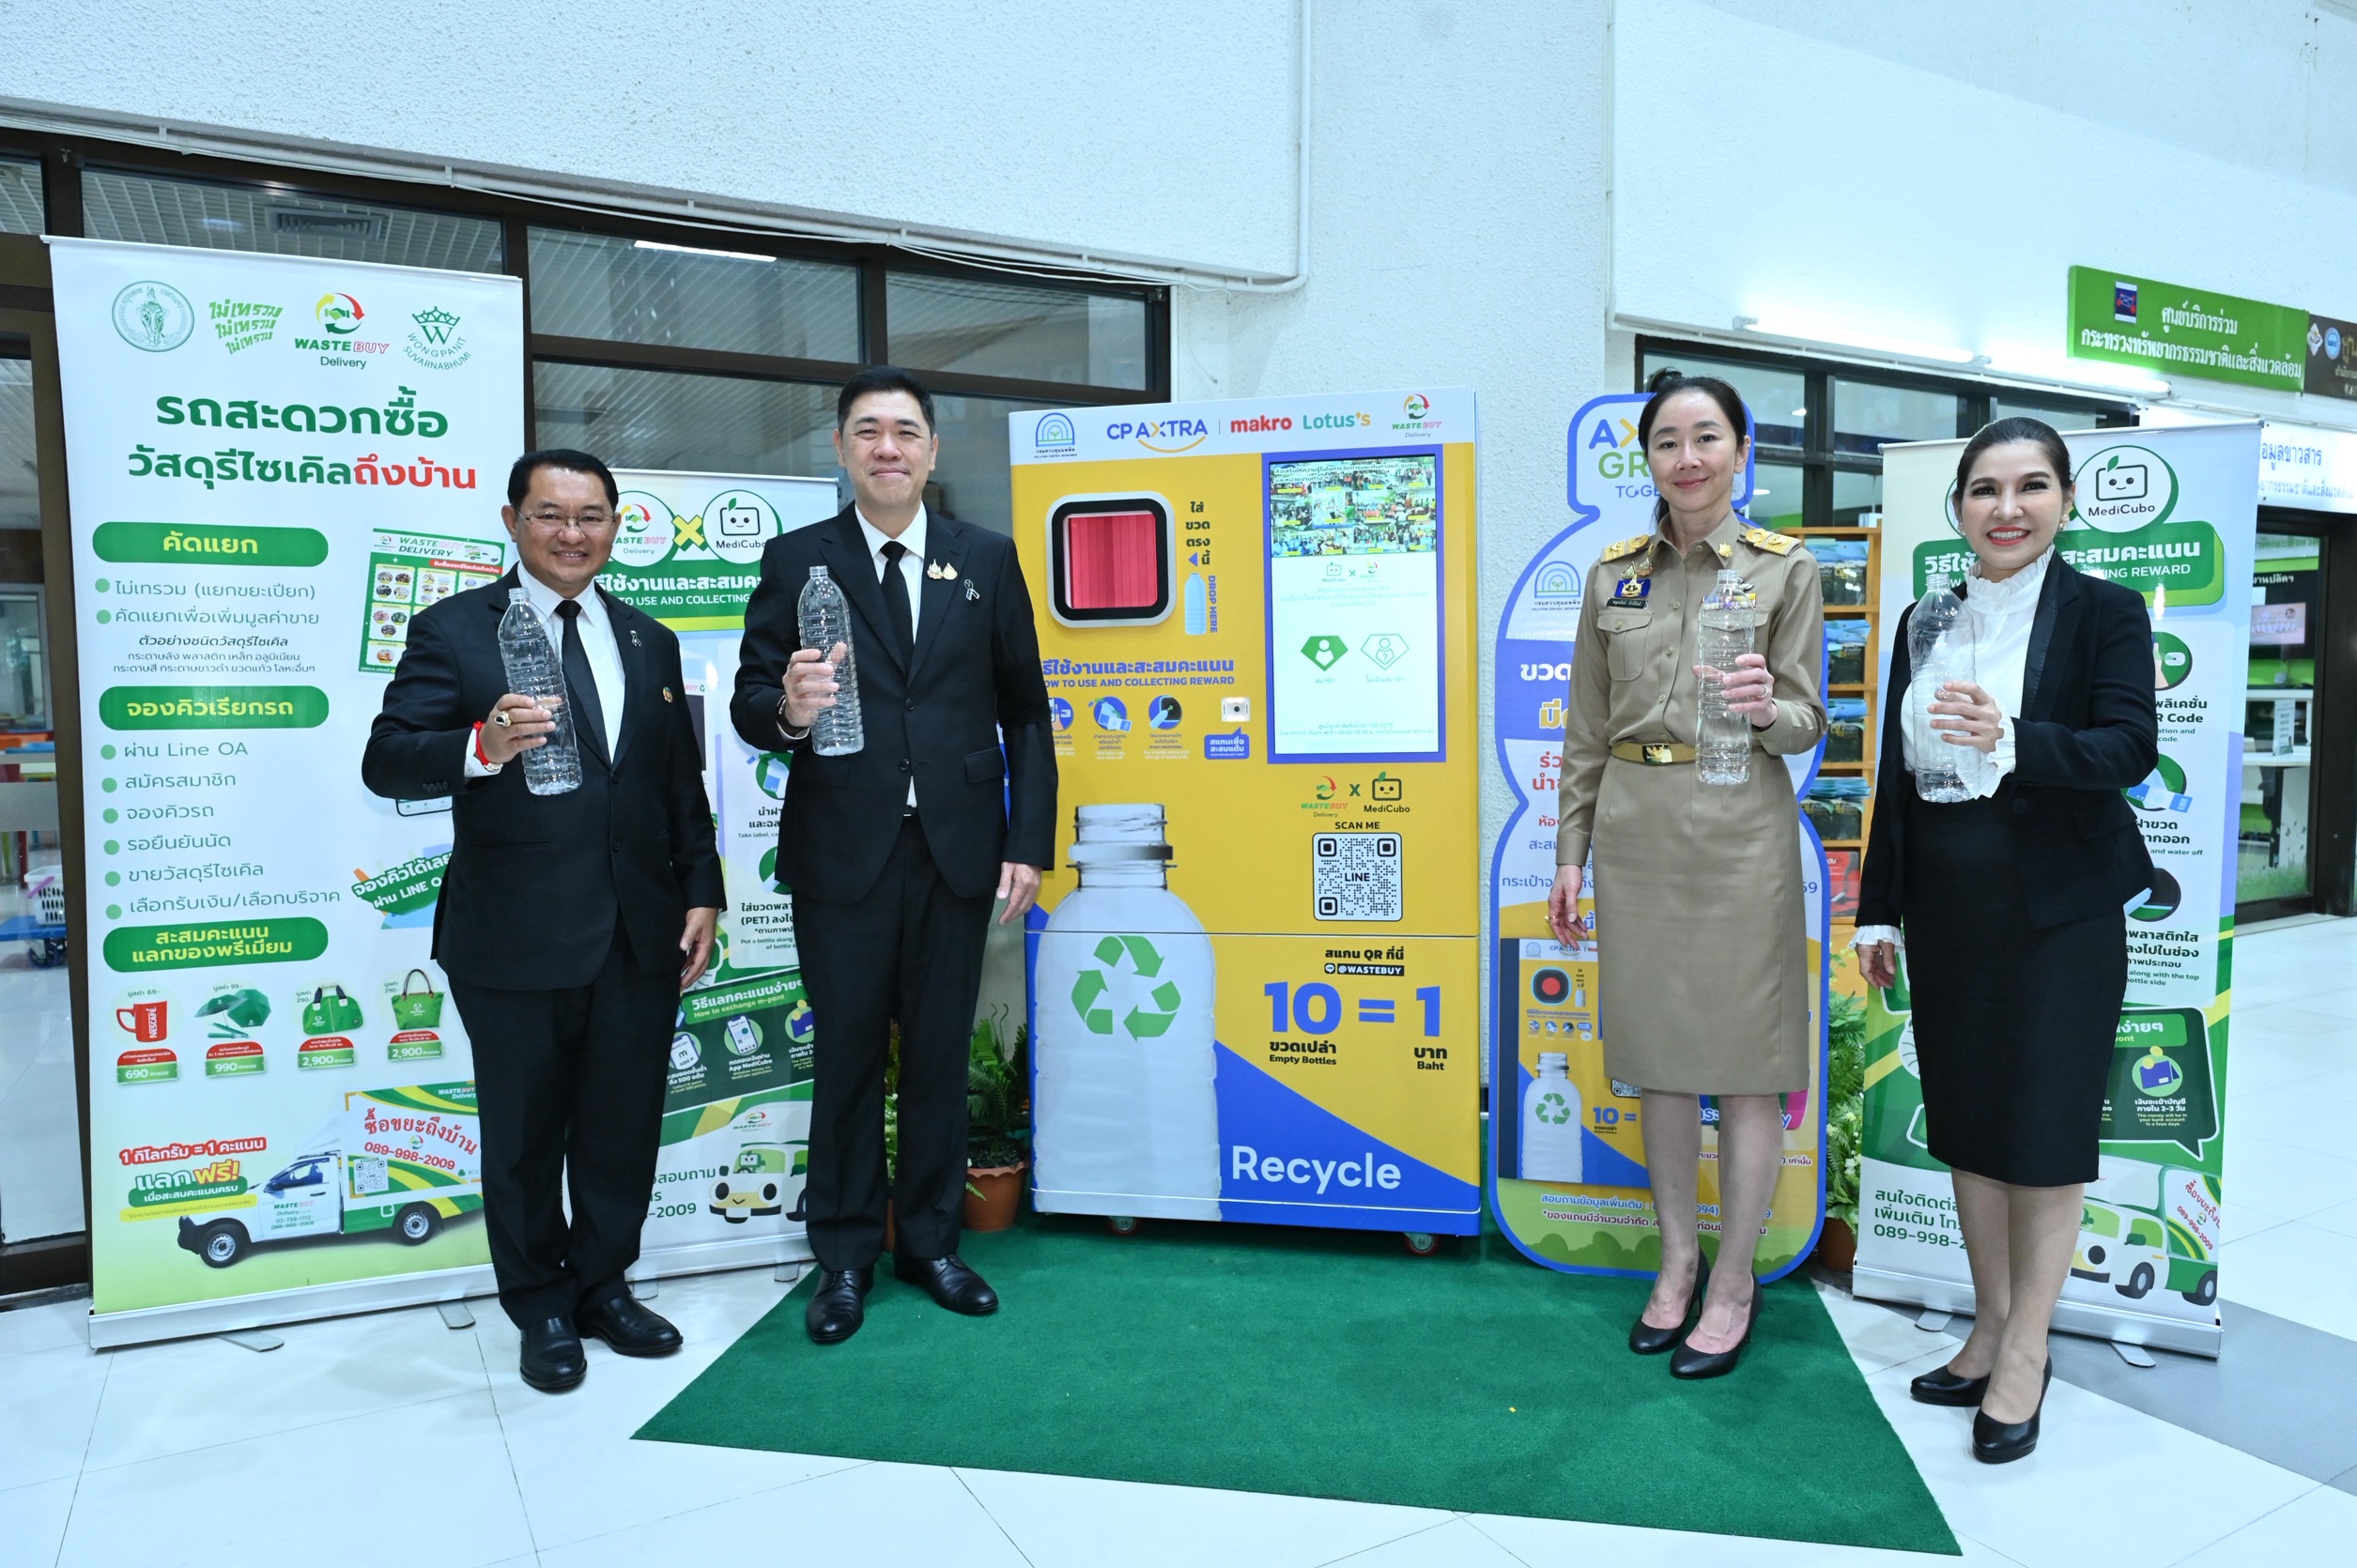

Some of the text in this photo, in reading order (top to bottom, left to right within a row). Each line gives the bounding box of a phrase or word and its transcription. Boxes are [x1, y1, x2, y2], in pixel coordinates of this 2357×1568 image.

[208, 299, 284, 319] ไม่เทรวม
[2162, 300, 2238, 334] ศูนย์บริการร่วม
[215, 319, 277, 339] ไม่เทรวม
[225, 331, 273, 355] ไม่เทรวม
[407, 332, 468, 358] WONGPANIT
[403, 346, 472, 370] SUVARNABHUMI
[2081, 329, 2302, 378] กระทรวงทรัพยากรธรรมชาติและสิ่งแวดล้อม
[320, 356, 367, 370] Delivery
[155, 386, 449, 438] รถสะดวกซื้อ
[1302, 412, 1371, 430] Lotus's
[1107, 419, 1208, 439] CP AXTRA
[1230, 414, 1293, 433] makro
[128, 444, 477, 490] วัสดุรีไซเคิลถึงบ้าน
[1190, 501, 1204, 514] ใส่
[2088, 504, 2155, 516] MediCubo
[1185, 520, 1210, 530] ขวด
[162, 530, 259, 554] คัดแยก
[1186, 537, 1210, 547] ตรง
[398, 546, 454, 558] DELIVERY
[1201, 550, 1210, 565] นี้
[2061, 542, 2200, 563] สะสมคะแนน
[2131, 564, 2191, 577] REWARD
[114, 579, 316, 601] ไม่เทรวม (แยกขยะเปียก)
[637, 593, 750, 606] USE AND COLLECTING
[1208, 575, 1218, 633] DROP HERE
[115, 606, 319, 627] คัดแยกเพื่อเพิ่มมูลค่าขาย
[138, 635, 288, 650] ตัวอย่างชนิดวัสดุรีไซเคิล
[128, 651, 179, 661] กระดาษลัง
[182, 650, 227, 661] พลาสติก
[229, 650, 254, 661] เหล็ก
[113, 663, 158, 673] กระดาษสี
[231, 663, 272, 673] ขวดแก้ว
[1042, 658, 1234, 676] ธีใช้งานและสะสมคะแนน
[1062, 676, 1235, 687] TO USE AND COLLECTING REWARD
[127, 697, 294, 717] จองคิวเรียกรถ
[2167, 714, 2203, 723] Code
[124, 742, 248, 758] ผ่าน Line OA
[125, 772, 237, 790] สมัครสมาชิก
[127, 804, 214, 820] จองคิวรถ
[1363, 805, 1410, 813] MediCubo
[128, 833, 231, 852] รอยืนยันนัด
[129, 862, 264, 884] ขายวัสดุรีไซเคิล
[1345, 872, 1370, 882] LINE
[130, 889, 341, 914] เลือกรับเงิน/เลือกบริจาค
[398, 881, 429, 904] LINE
[741, 915, 769, 926] (PET)
[156, 924, 269, 945] สะสมคะแนน
[2129, 930, 2199, 942] พลาสติกใส
[132, 939, 293, 963] แลกของพรีเมียม
[1325, 945, 1404, 961] สแกน QR ที่นี่
[1338, 965, 1401, 975] @WASTEBUY
[721, 1000, 756, 1013] exchange
[758, 994, 785, 1005] m-pont
[1264, 981, 1342, 1036] 10
[1416, 986, 1440, 1038] 1
[146, 1007, 158, 1038] NESCAFÉ
[392, 1048, 423, 1059] 2,900
[1269, 1040, 1336, 1053] ขวดเปล่า
[1414, 1047, 1447, 1059] บาท
[215, 1063, 238, 1073] 990
[302, 1055, 334, 1068] 2,900
[1269, 1054, 1337, 1065] Empty Bottles
[1417, 1061, 1444, 1070] Baht
[125, 1068, 148, 1079] 690
[1593, 1107, 1619, 1125] 10
[364, 1107, 477, 1155] ซื้อขยะถึงบ้าน
[122, 1152, 129, 1163] 1
[134, 1145, 189, 1162] กิโลกรัม
[208, 1142, 214, 1153] 1
[220, 1138, 264, 1151] คะแนน
[364, 1141, 455, 1170] 089-998-2009
[1232, 1145, 1401, 1194] Recycle
[1789, 1156, 1811, 1165] เท่านั้น
[144, 1184, 239, 1203] เมื่อสะสมคะแนนครบ
[1541, 1194, 1642, 1209] สอบถามข้อมูลเพิ่มเติม
[649, 1203, 697, 1218] -2009
[1874, 1204, 1934, 1226] เพิ่มเติม
[1874, 1224, 1966, 1249] 089-998-2
[2178, 1206, 2213, 1250] 089-998-2009
